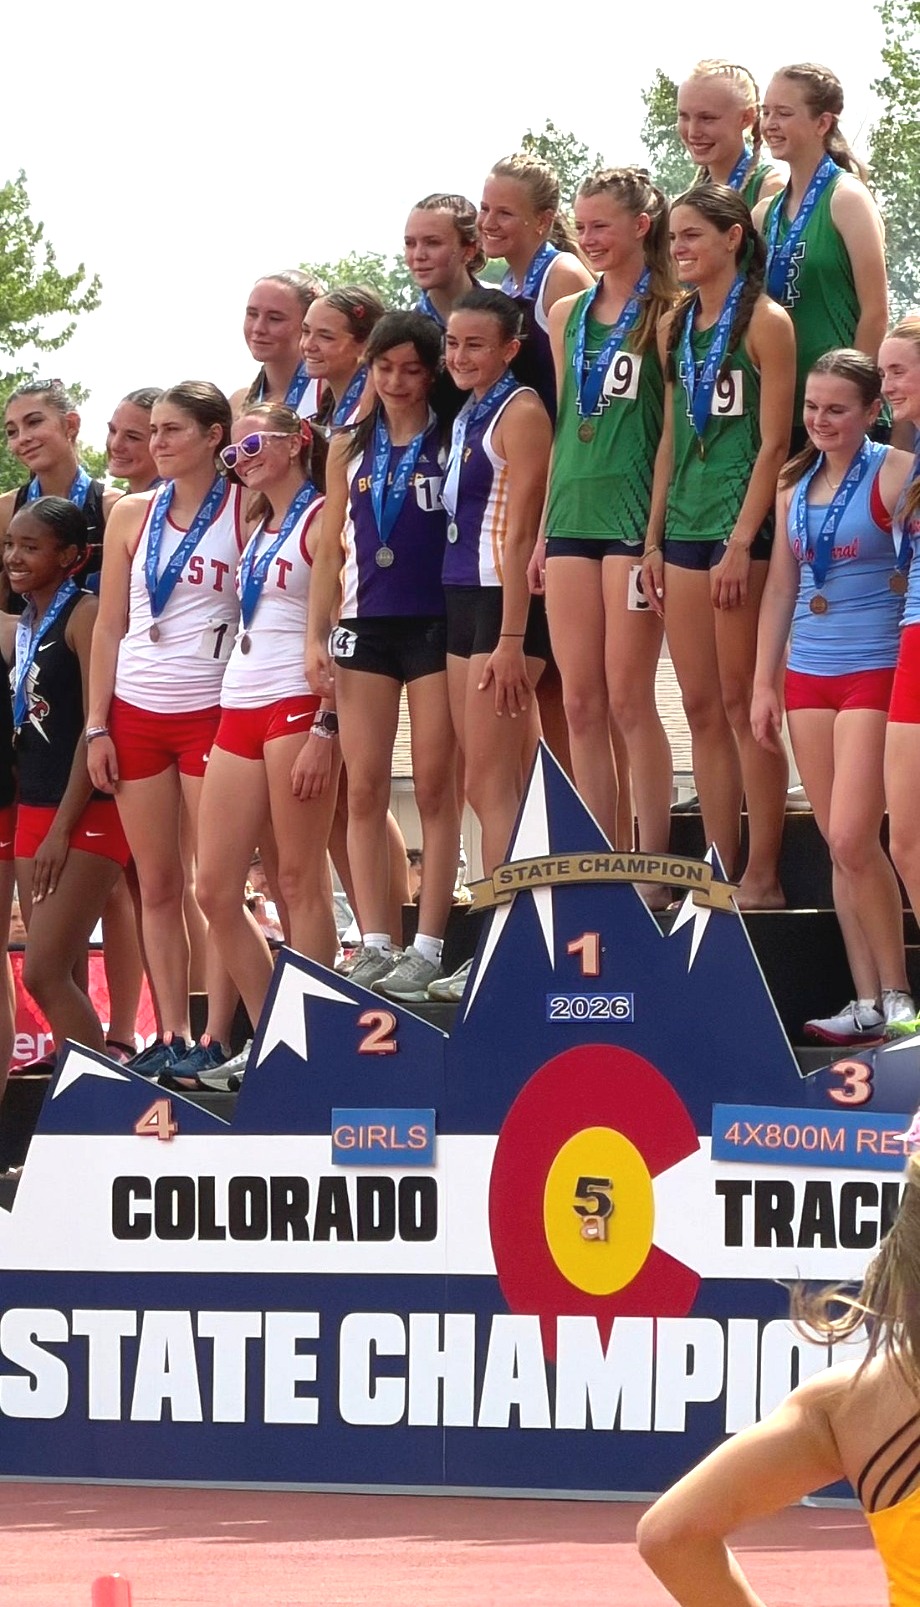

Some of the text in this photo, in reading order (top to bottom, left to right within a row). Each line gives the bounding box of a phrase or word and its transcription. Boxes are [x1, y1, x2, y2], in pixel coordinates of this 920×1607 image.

[612, 356, 634, 395] 9
[716, 373, 736, 413] 9
[213, 623, 229, 659] 1
[500, 858, 703, 884] STATE CHAMPION
[567, 931, 600, 976] 1
[550, 996, 630, 1020] 2026
[357, 1010, 398, 1055] 2
[827, 1059, 874, 1106] 3
[134, 1099, 178, 1141] 4
[333, 1125, 428, 1149] GIRLS
[724, 1121, 845, 1152] 4X800M
[112, 1176, 437, 1242] COLORADO
[573, 1176, 614, 1217] 5
[580, 1214, 609, 1242] a
[0, 1308, 868, 1434] STATE CHAMPIO
